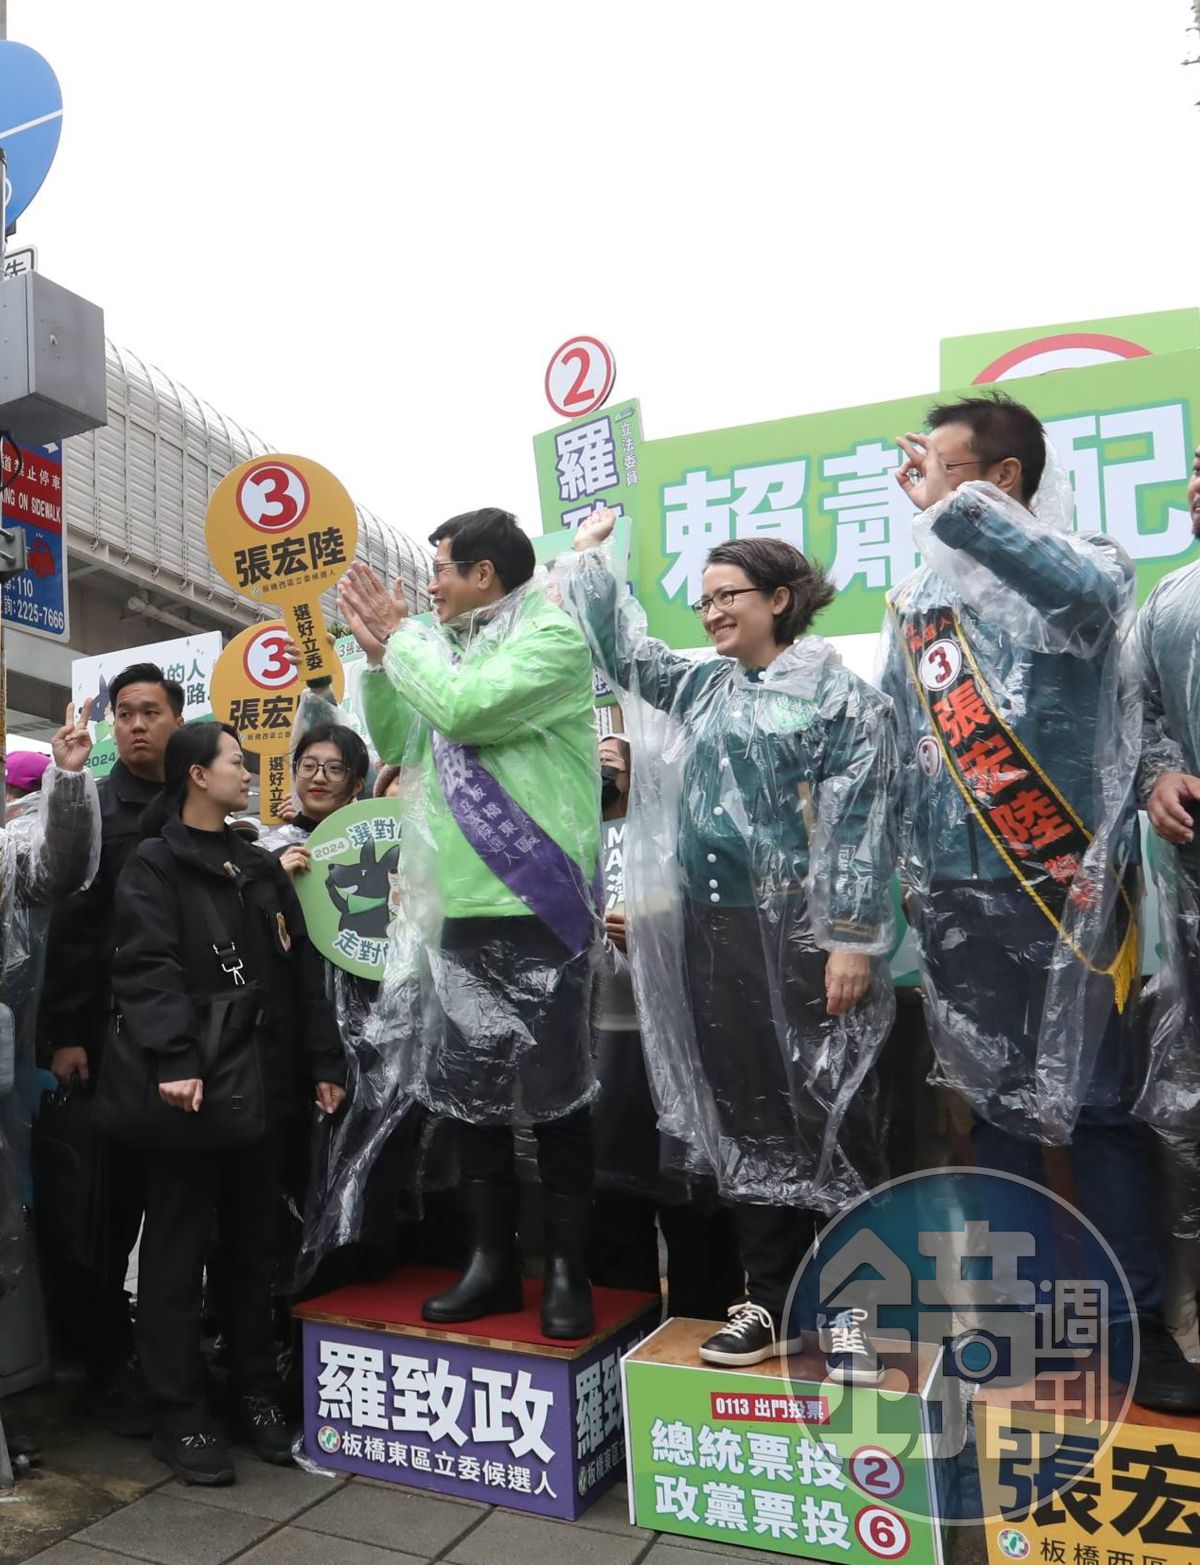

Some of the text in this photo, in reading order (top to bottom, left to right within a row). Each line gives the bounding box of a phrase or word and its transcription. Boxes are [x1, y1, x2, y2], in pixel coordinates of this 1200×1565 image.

[562, 347, 596, 408] 2
[618, 421, 640, 488] 立法委員
[18, 492, 29, 511] ON
[31, 497, 62, 524] SIDEWALK
[250, 467, 299, 527] 3
[233, 526, 347, 588] 張宏陸
[260, 636, 294, 679] 3
[292, 603, 324, 671] 選好立委
[928, 646, 953, 684] 3
[163, 658, 206, 685] 的人
[229, 694, 300, 733] 張宏
[85, 751, 116, 769] 2024
[932, 677, 1074, 858] 張宏陸
[313, 841, 346, 858] 2024
[317, 1340, 556, 1463] 羅致政
[715, 1396, 825, 1420] 0113 出門投票
[341, 1431, 557, 1499] 板橋東區立委候選人
[649, 1418, 891, 1491] 總統票投 2
[653, 1474, 897, 1551] 政黨票投 6
